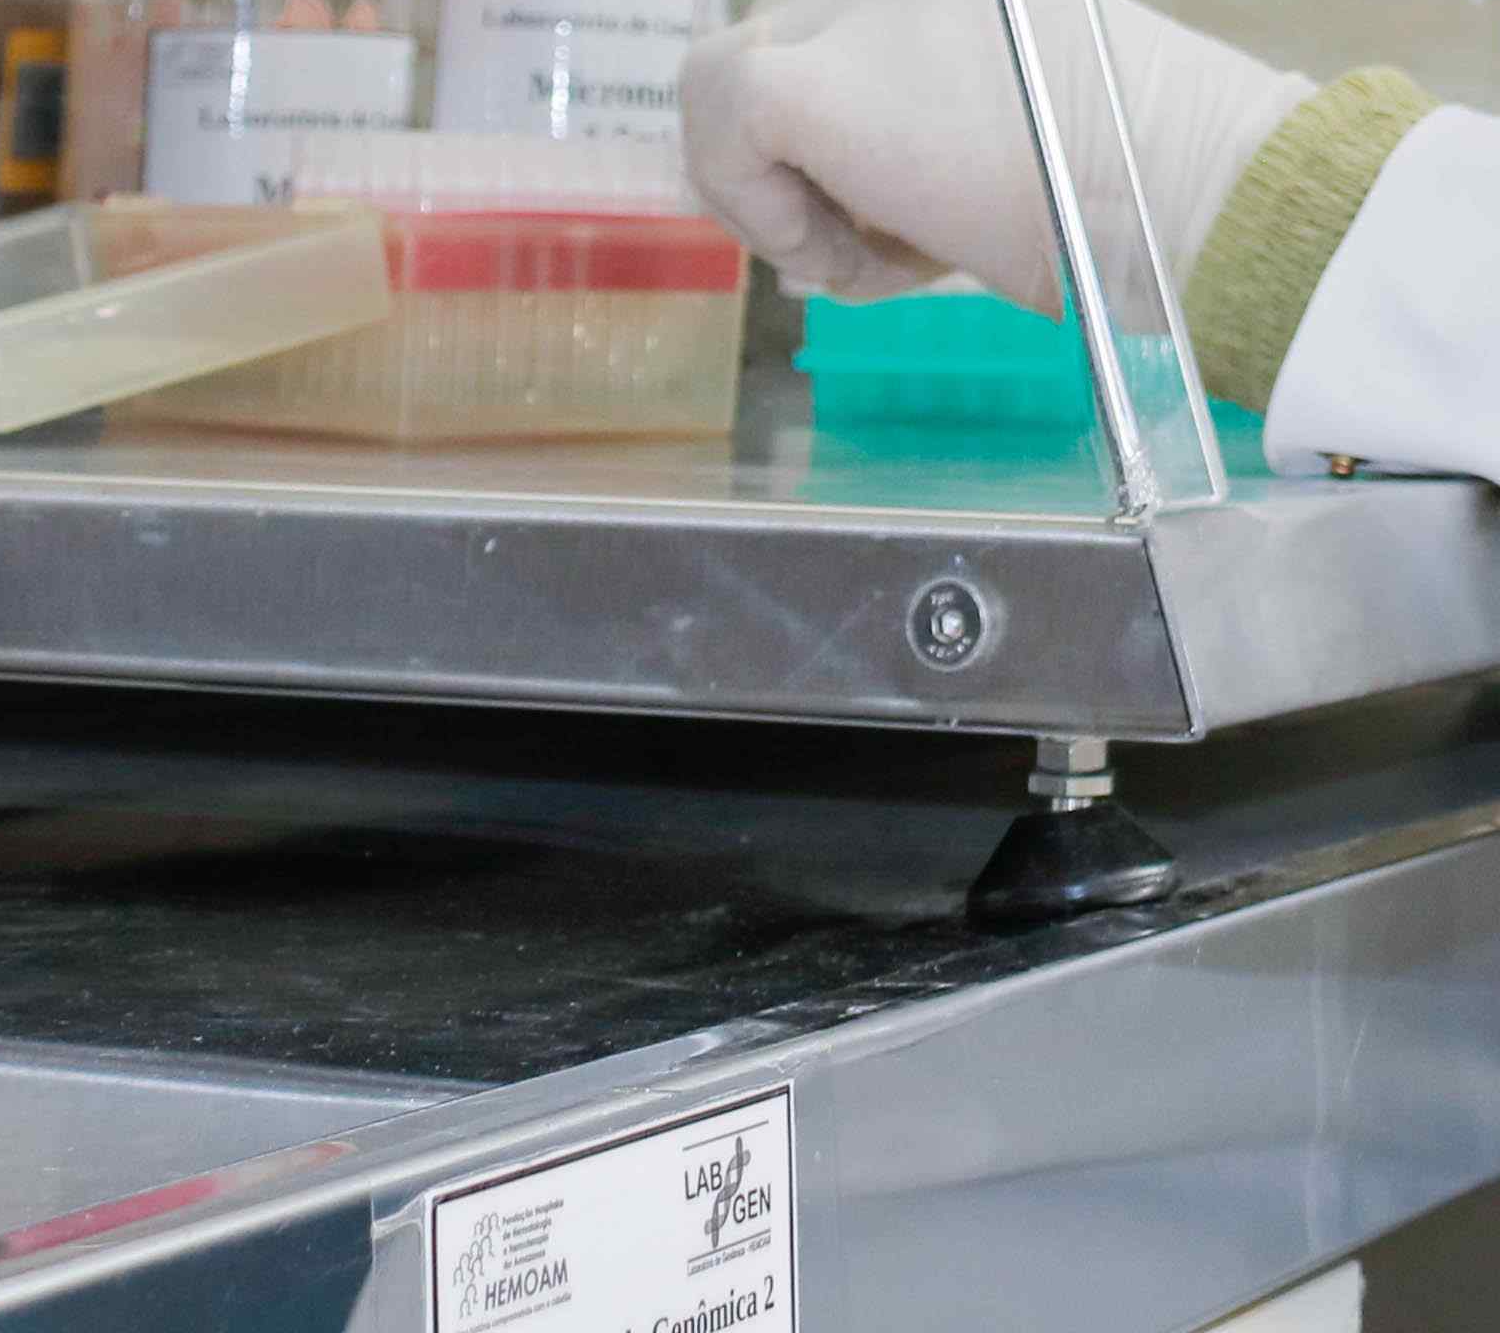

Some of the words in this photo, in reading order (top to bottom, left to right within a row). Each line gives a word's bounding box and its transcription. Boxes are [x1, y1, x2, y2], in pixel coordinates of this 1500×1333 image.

[684, 1161, 723, 1201] LAB
[733, 1182, 772, 1224] GEN
[485, 1258, 569, 1311] HEMOAM
[764, 1273, 776, 1311] 2
